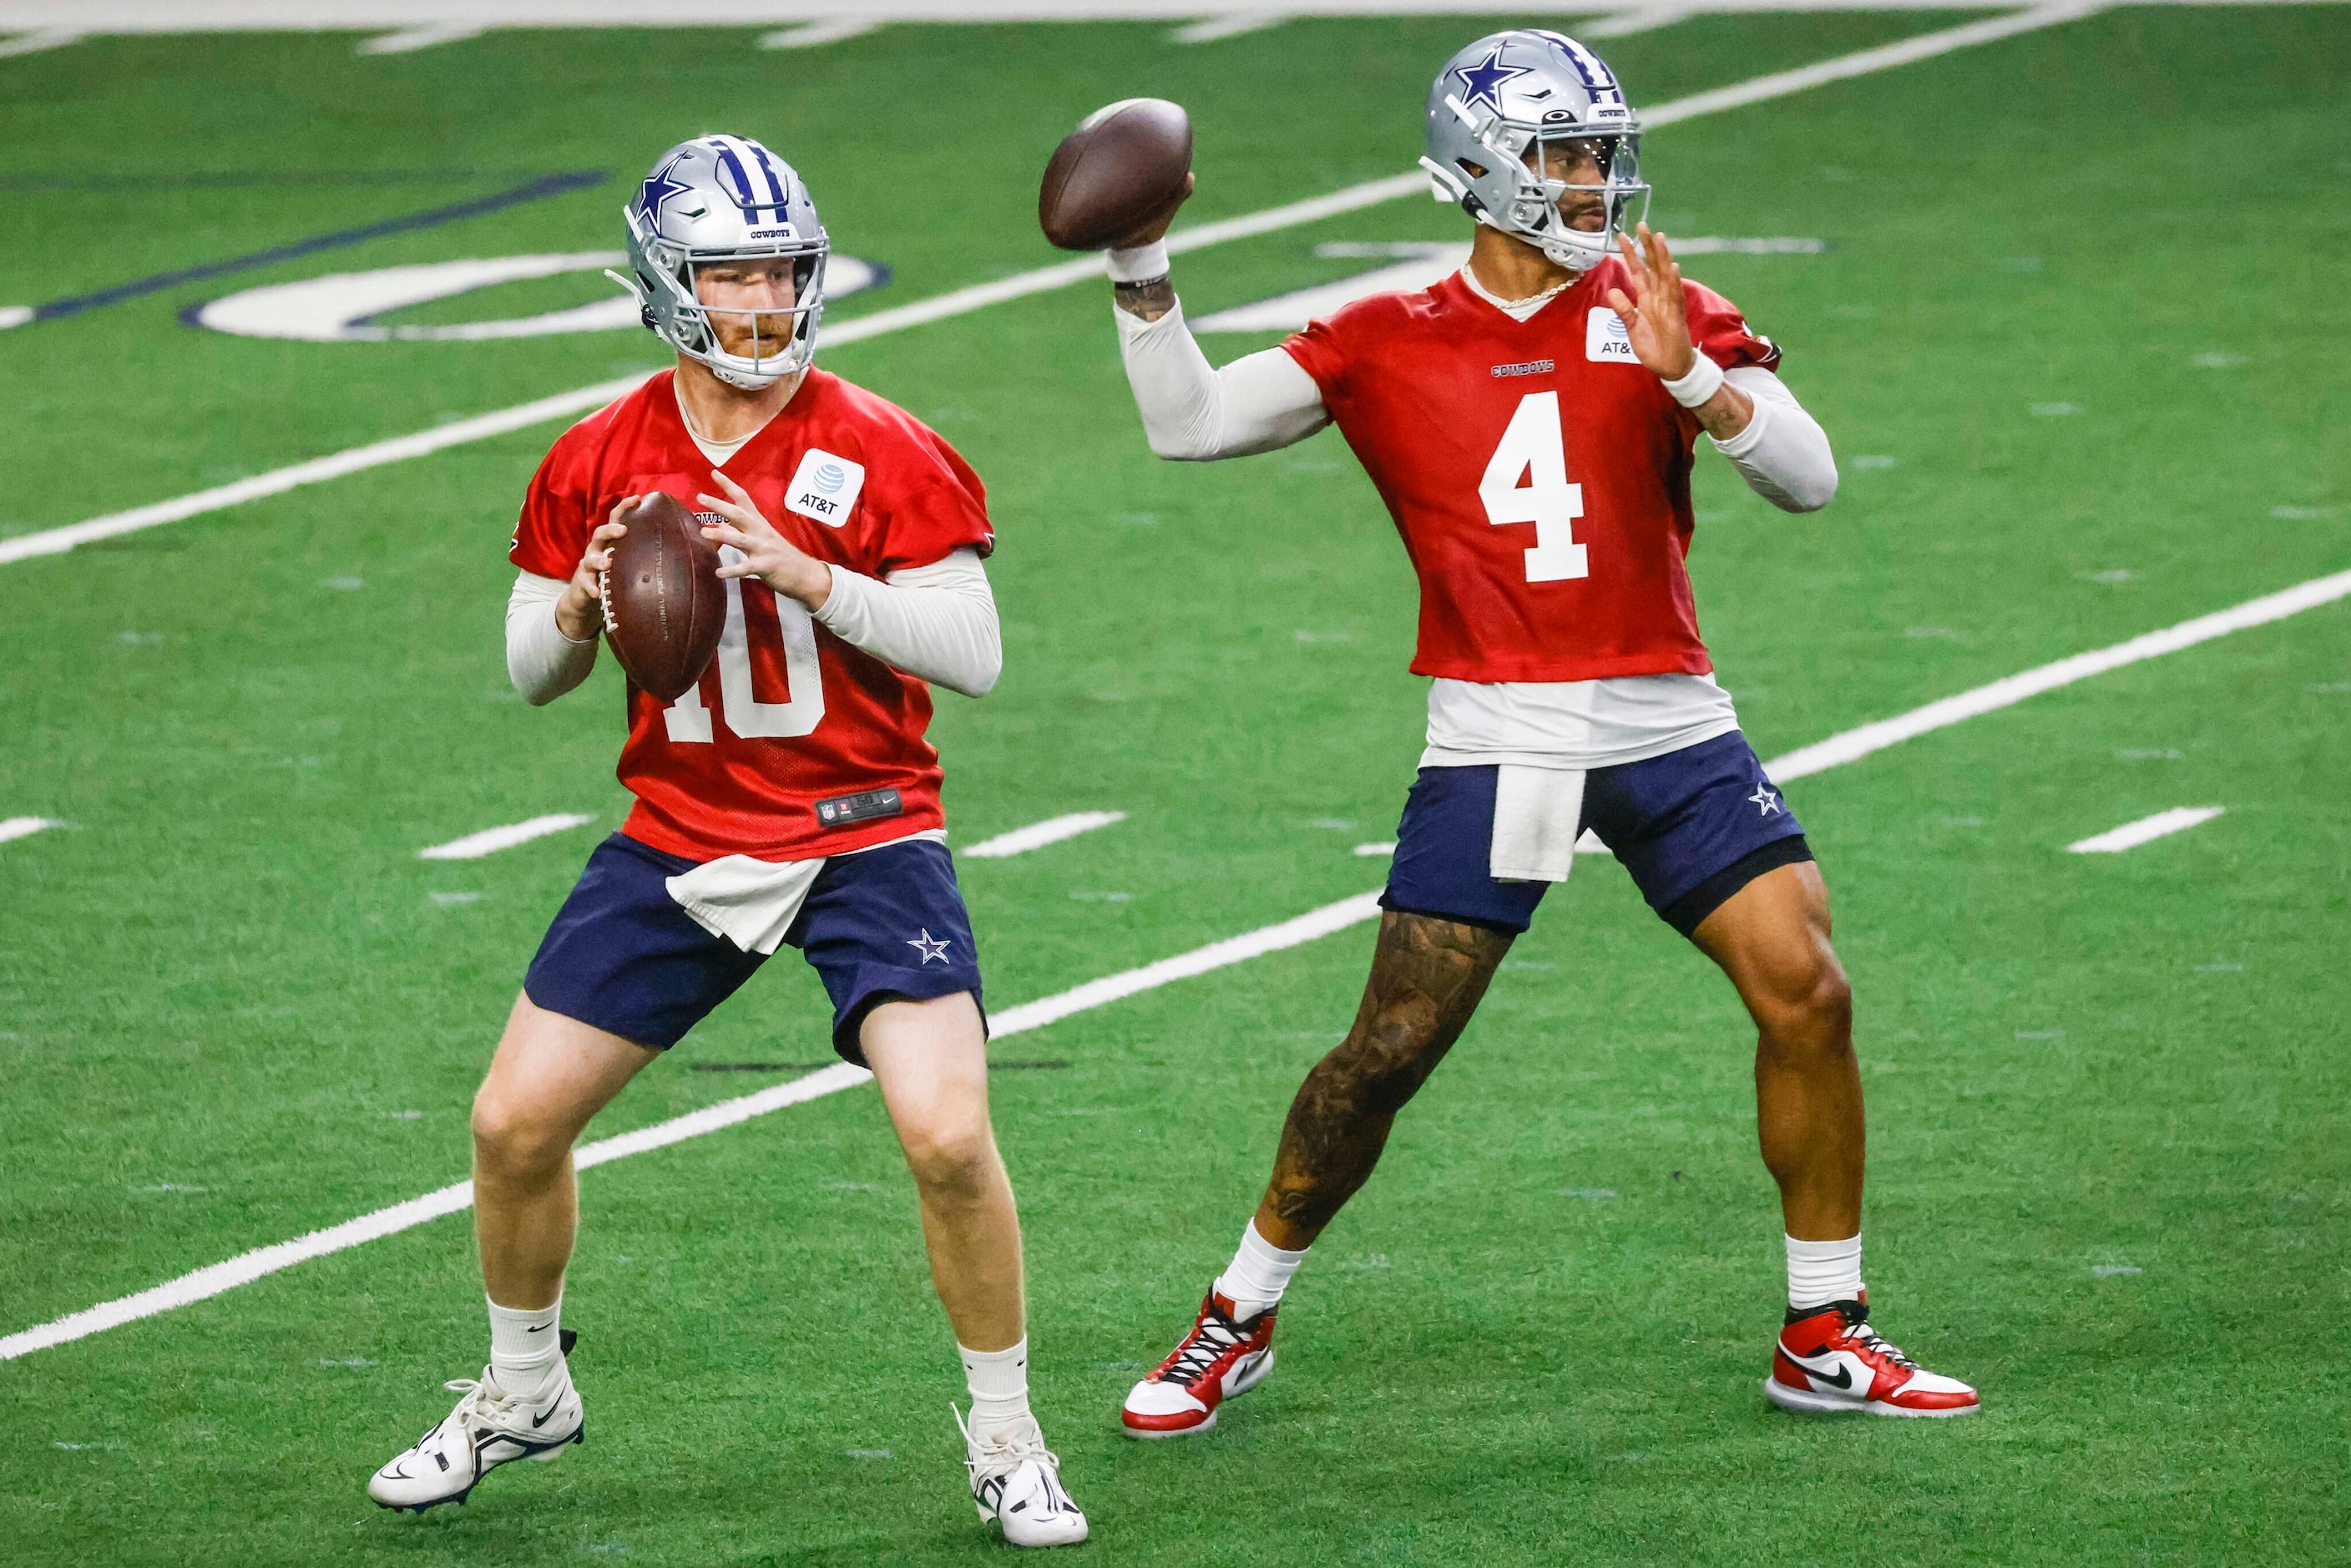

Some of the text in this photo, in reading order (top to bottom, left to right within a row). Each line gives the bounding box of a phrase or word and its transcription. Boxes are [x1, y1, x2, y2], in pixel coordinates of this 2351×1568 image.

[751, 230, 790, 239] COWBOYS
[1601, 342, 1631, 354] AT&
[1490, 359, 1554, 377] COWBOYS
[1478, 390, 1589, 583] 4
[798, 493, 838, 515] AT&T
